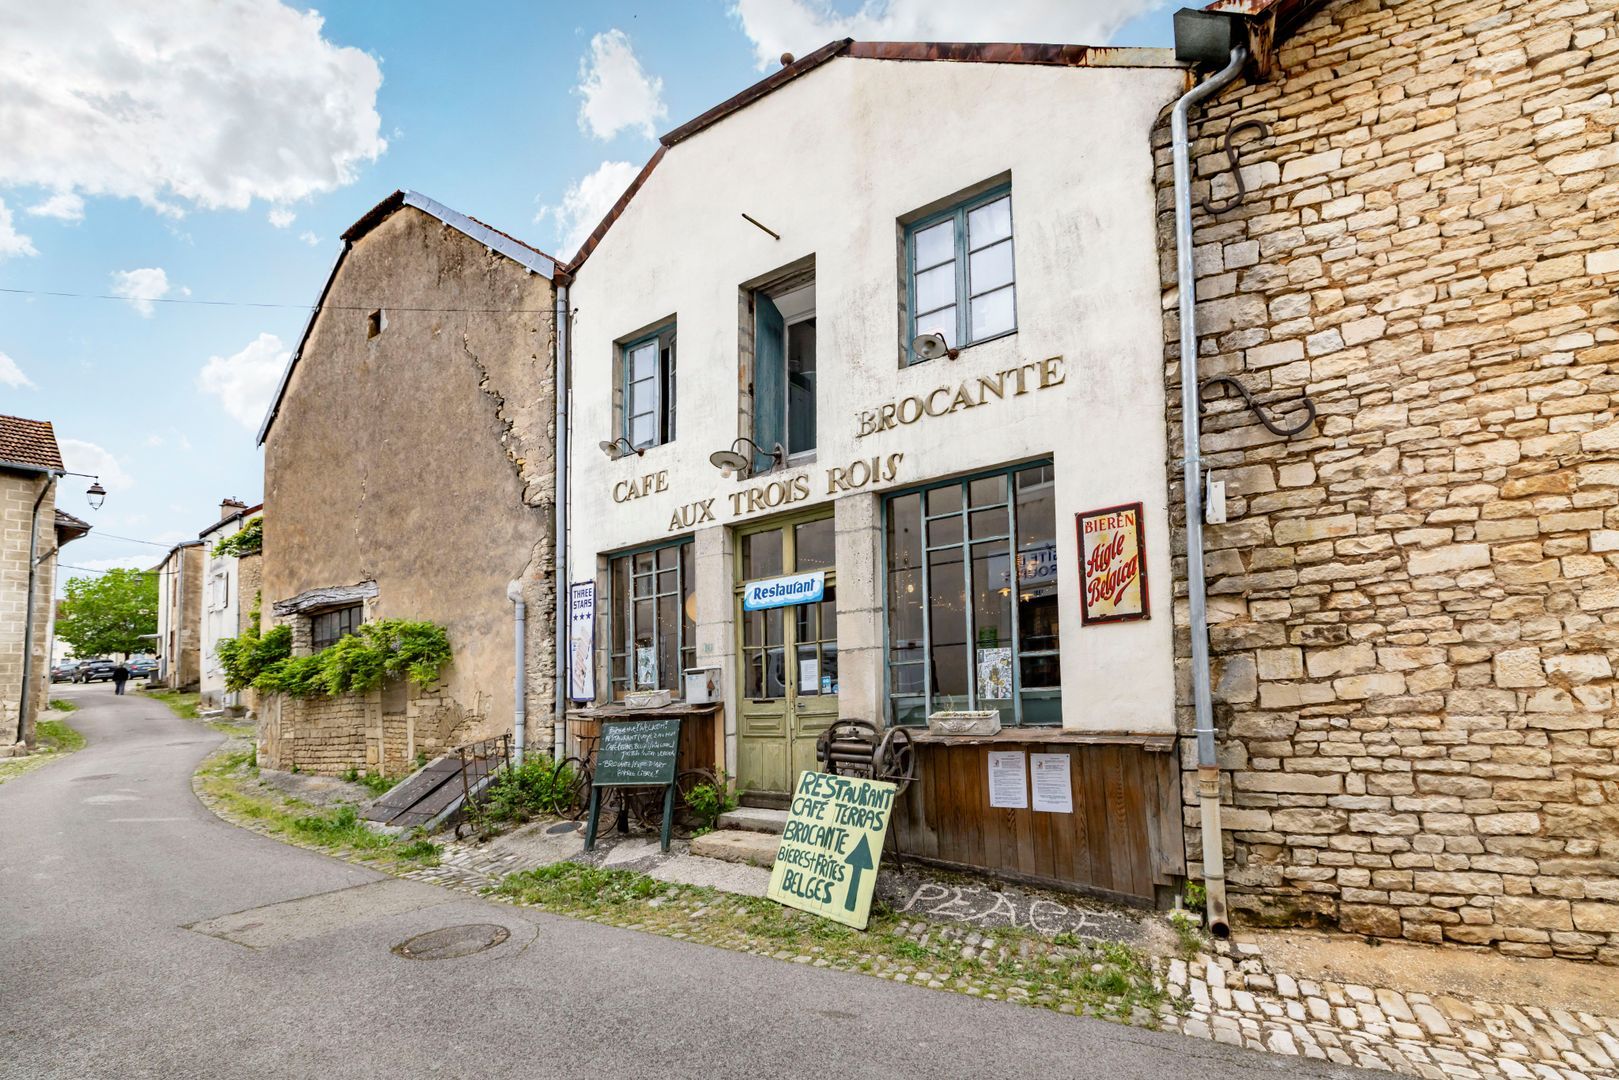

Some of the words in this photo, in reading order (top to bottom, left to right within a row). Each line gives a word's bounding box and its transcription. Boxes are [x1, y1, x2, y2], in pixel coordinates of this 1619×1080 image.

[855, 355, 1066, 438] BROCANTE
[612, 469, 670, 504] CAFE
[668, 497, 716, 532] AUX
[728, 473, 810, 517] TROIS
[825, 452, 904, 495] ROIS
[1084, 512, 1135, 534] BIEREN
[1086, 530, 1126, 578] Aigle
[573, 588, 593, 600] THREE
[753, 578, 816, 601] Restaurant
[1087, 554, 1138, 607] Belgica
[573, 599, 593, 610] STARS
[798, 771, 896, 810] RESTAURANT
[791, 797, 829, 821] CAFÉ
[834, 803, 885, 832] TERRAS
[783, 820, 850, 855] BROCANTE
[781, 869, 836, 905] BELGES
